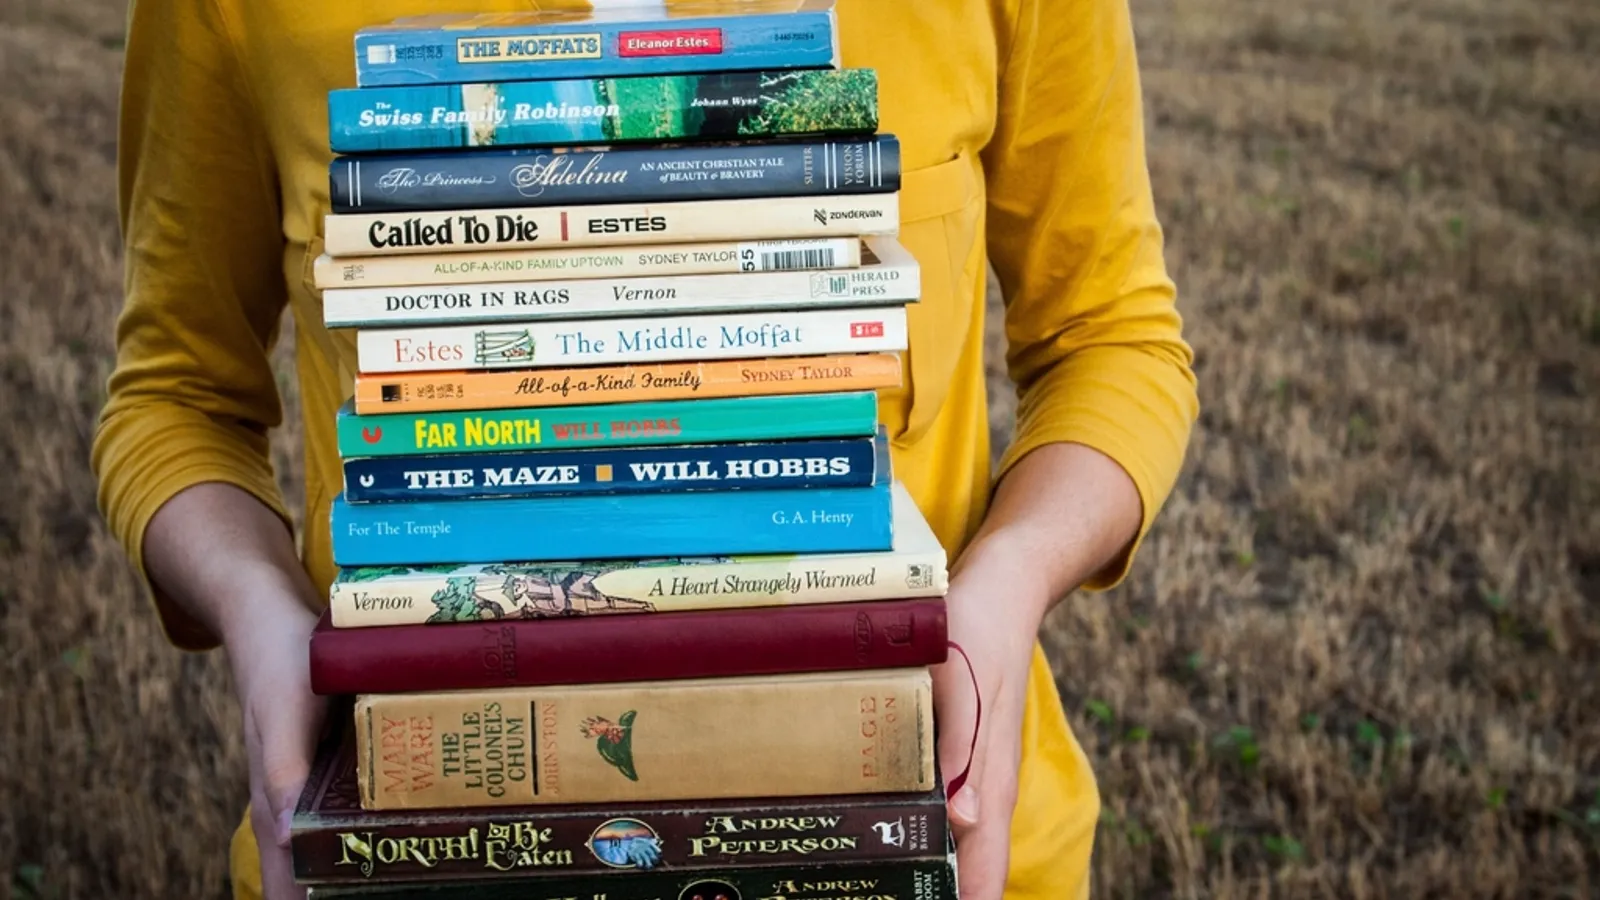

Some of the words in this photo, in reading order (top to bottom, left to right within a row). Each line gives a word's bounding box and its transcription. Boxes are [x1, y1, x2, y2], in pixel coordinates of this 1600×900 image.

[460, 42, 500, 58] THE
[506, 37, 598, 57] MOFFATS
[627, 38, 674, 50] Eleanor
[676, 36, 709, 48] Estes
[359, 109, 423, 128] Swiss
[431, 106, 507, 125] Family
[514, 101, 620, 121] Robinson
[376, 102, 392, 110] The
[690, 97, 728, 107] Johann
[731, 96, 758, 106] Wyss
[375, 167, 421, 195] The
[422, 172, 497, 188] Princess
[509, 153, 629, 197] Adelina
[640, 162, 651, 171] AN
[651, 161, 701, 171] ANCIENT
[703, 158, 758, 169] CHRISTIAN
[760, 157, 785, 167] TALE
[659, 172, 670, 183] of
[669, 171, 709, 182] BEAUTY
[720, 169, 766, 180] BRAVERY
[804, 147, 813, 185] SUTTER
[843, 145, 852, 185] VISION
[856, 144, 864, 184] FORUM
[368, 216, 453, 249] Called
[459, 215, 490, 244] To
[495, 214, 539, 242] Die
[588, 216, 667, 233] ESTES
[434, 260, 523, 275] ALL-OF-A-KIND
[527, 258, 568, 270] FAMILY
[570, 256, 624, 268] UPTOWN
[638, 253, 688, 266] SYDNEY
[692, 250, 738, 263] TAYLOR
[851, 270, 900, 283] HERALD
[386, 292, 472, 311] DOCTOR
[481, 292, 505, 307] IN
[514, 289, 570, 305] RAGS
[612, 286, 676, 300] Vernon
[852, 284, 887, 296] PRESS
[394, 338, 463, 364] Estes
[555, 331, 605, 356] The
[617, 327, 708, 354] Middle
[720, 322, 804, 349] Moffat
[514, 374, 636, 397] All-of-a-Kind
[641, 369, 702, 391] Family
[741, 368, 794, 383] SYDNEY
[799, 366, 853, 381] TAYLOR
[415, 420, 457, 449] FAR
[464, 417, 542, 447] NORTH
[552, 422, 605, 441] WILL
[611, 417, 681, 440] HOBBS
[404, 469, 474, 490] THE
[483, 464, 580, 487] MAZE
[630, 460, 721, 482] WILL
[724, 456, 851, 479] HOBBS
[348, 522, 370, 537] For
[374, 521, 401, 536] The
[404, 520, 451, 538] Temple
[772, 510, 789, 525] G.
[792, 510, 808, 525] A.
[812, 509, 854, 528] Henty
[648, 579, 665, 598] A
[670, 575, 719, 597] Heart
[723, 571, 802, 595] Strangely
[804, 568, 876, 590] Warmed
[352, 591, 414, 612] Vernon
[463, 711, 484, 790] LITTLE
[484, 701, 506, 799] COLONEL'S
[507, 716, 526, 782] CHUM
[541, 703, 559, 794] JOHNSTON
[860, 696, 879, 779] PAGE
[382, 714, 408, 794] MARY
[409, 713, 434, 793] WARE
[442, 732, 462, 778] THE
[511, 821, 552, 850] Be
[705, 814, 842, 834] ANDREW
[909, 814, 917, 850] WATER
[920, 814, 928, 850] BROOK
[334, 826, 479, 878] NORTH!
[485, 839, 573, 870] Eaten
[687, 836, 860, 858] PETERSON
[772, 879, 879, 894] ANDREW
